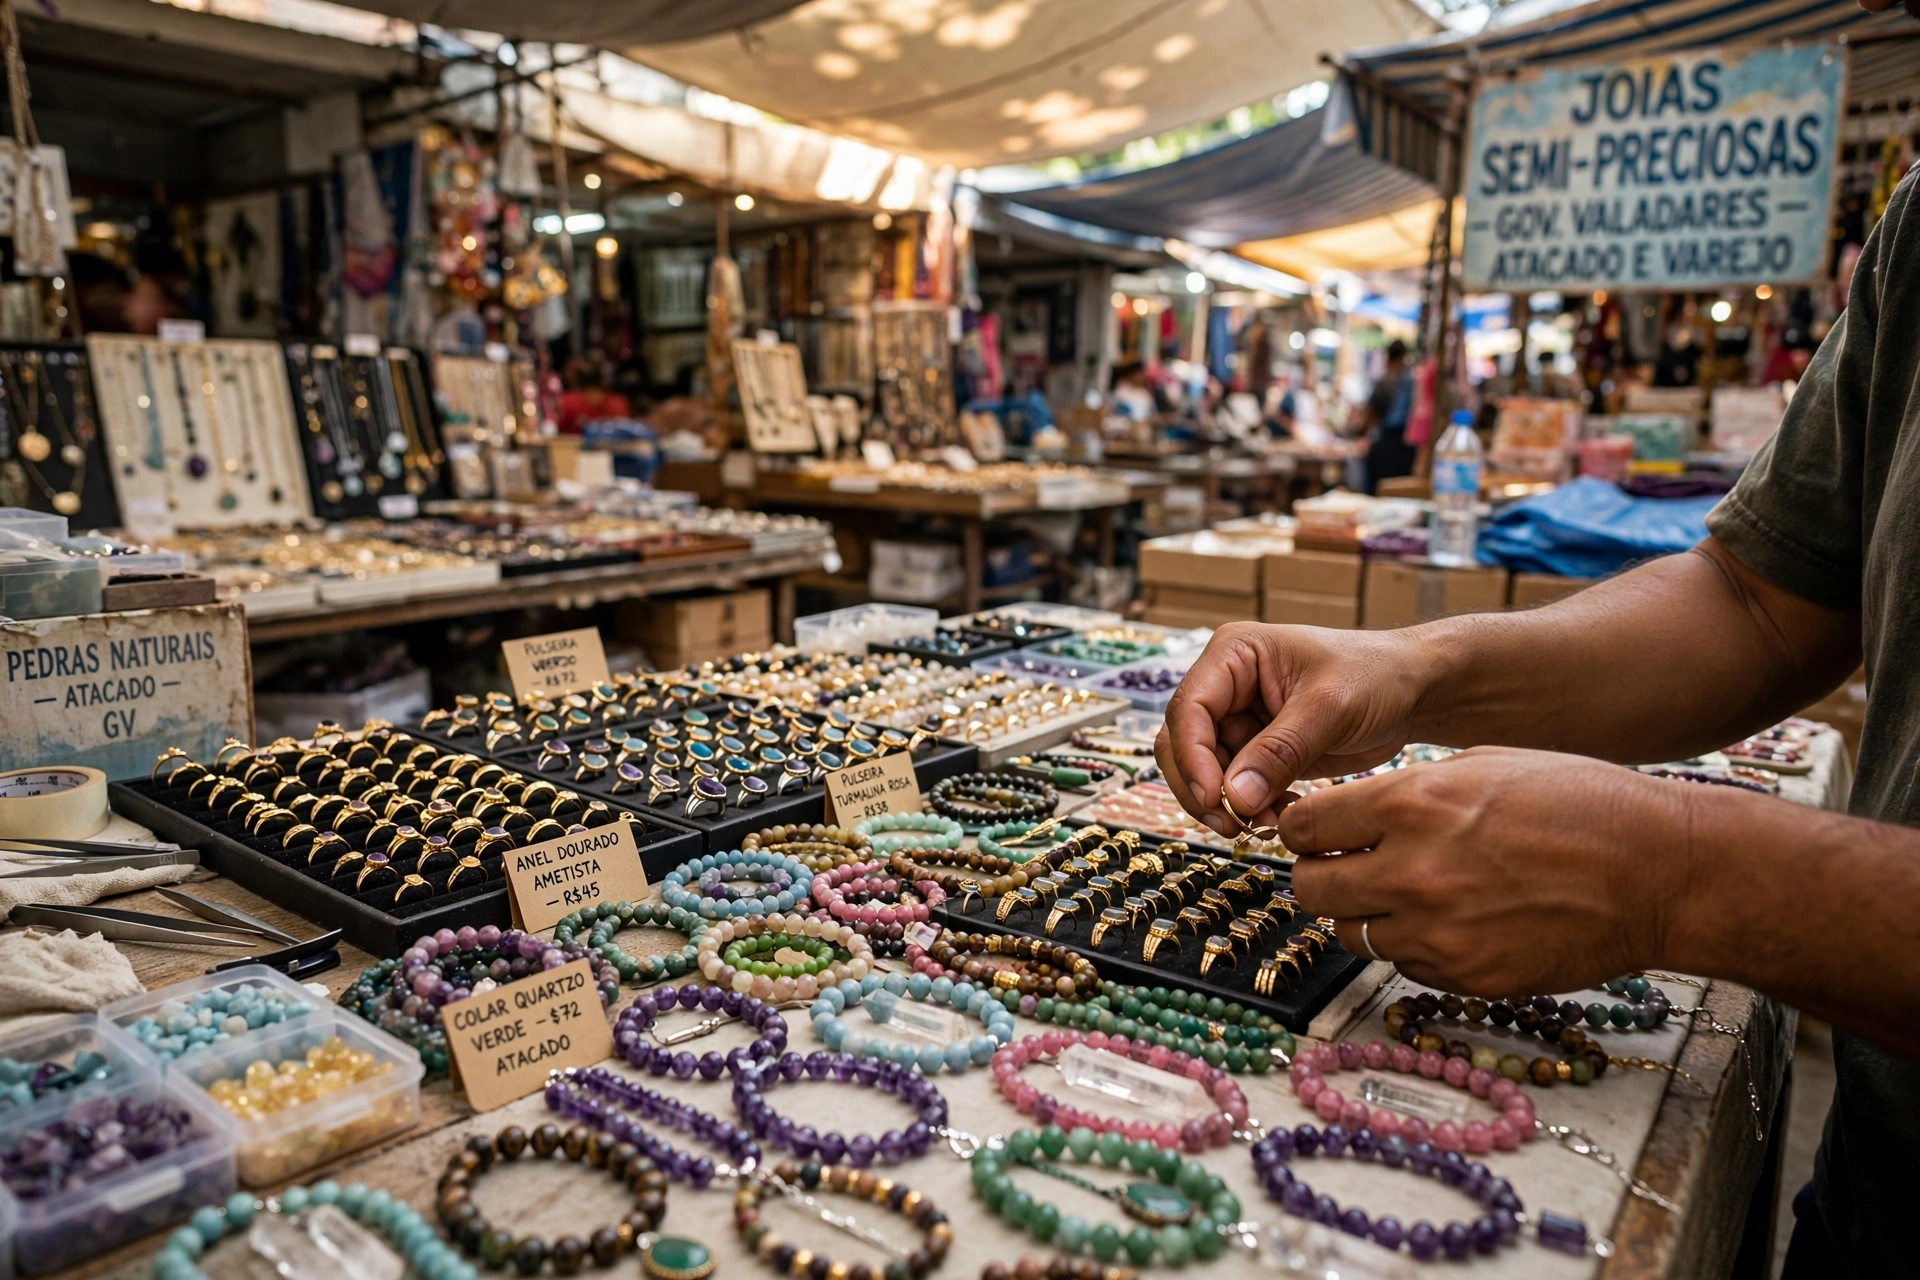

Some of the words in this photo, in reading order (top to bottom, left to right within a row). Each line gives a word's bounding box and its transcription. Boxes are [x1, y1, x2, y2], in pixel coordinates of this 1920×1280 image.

[1571, 61, 1723, 124] JOIAS
[1480, 113, 1822, 196] SEMI-PRECIOSAS
[1572, 188, 1769, 235] VALADARES
[1488, 248, 1626, 285] ATACADO
[1634, 243, 1650, 279] E
[1663, 234, 1794, 275] VAREJO
[6, 642, 100, 682] PEDRAS
[110, 631, 215, 670] NATURAIS
[65, 675, 156, 708] ATACADO
[103, 708, 136, 739] GV
[835, 783, 887, 808] TURMALINA
[888, 776, 912, 791] ROSA
[840, 766, 885, 787] PULSEIRA
[516, 851, 553, 872] ANEL
[557, 832, 619, 860] DOURADO
[534, 859, 601, 891] AMETISTA
[563, 881, 600, 906] R$45
[454, 999, 510, 1031] COLAR
[514, 972, 585, 1009] QUARTZO
[471, 1019, 527, 1052] VERDE
[496, 1034, 571, 1076] ATACADO
